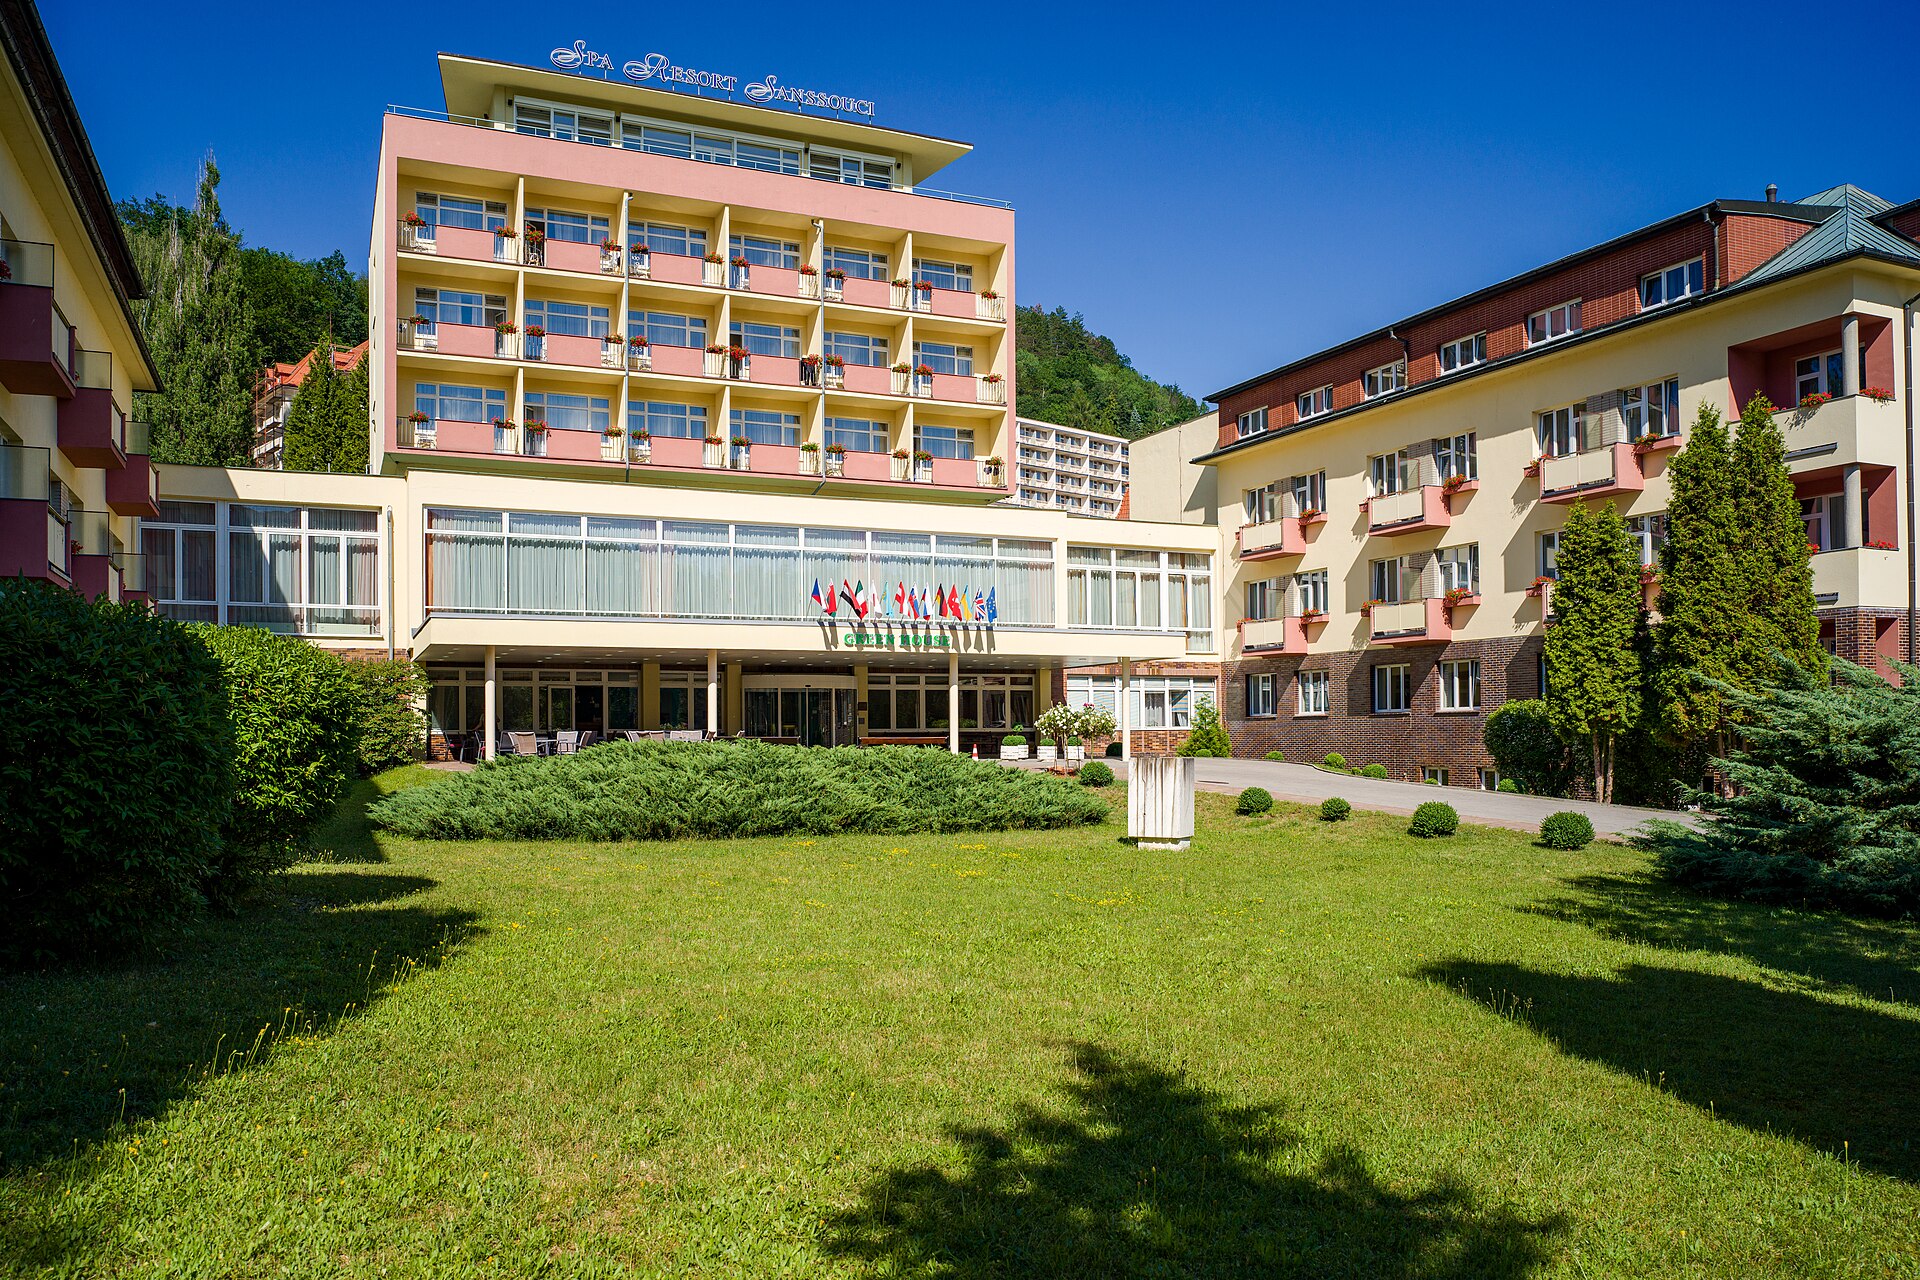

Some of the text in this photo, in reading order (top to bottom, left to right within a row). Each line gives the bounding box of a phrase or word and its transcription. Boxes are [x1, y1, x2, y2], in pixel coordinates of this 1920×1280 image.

[623, 53, 737, 92] RESORT
[843, 633, 951, 647] GREEN HOUSE
